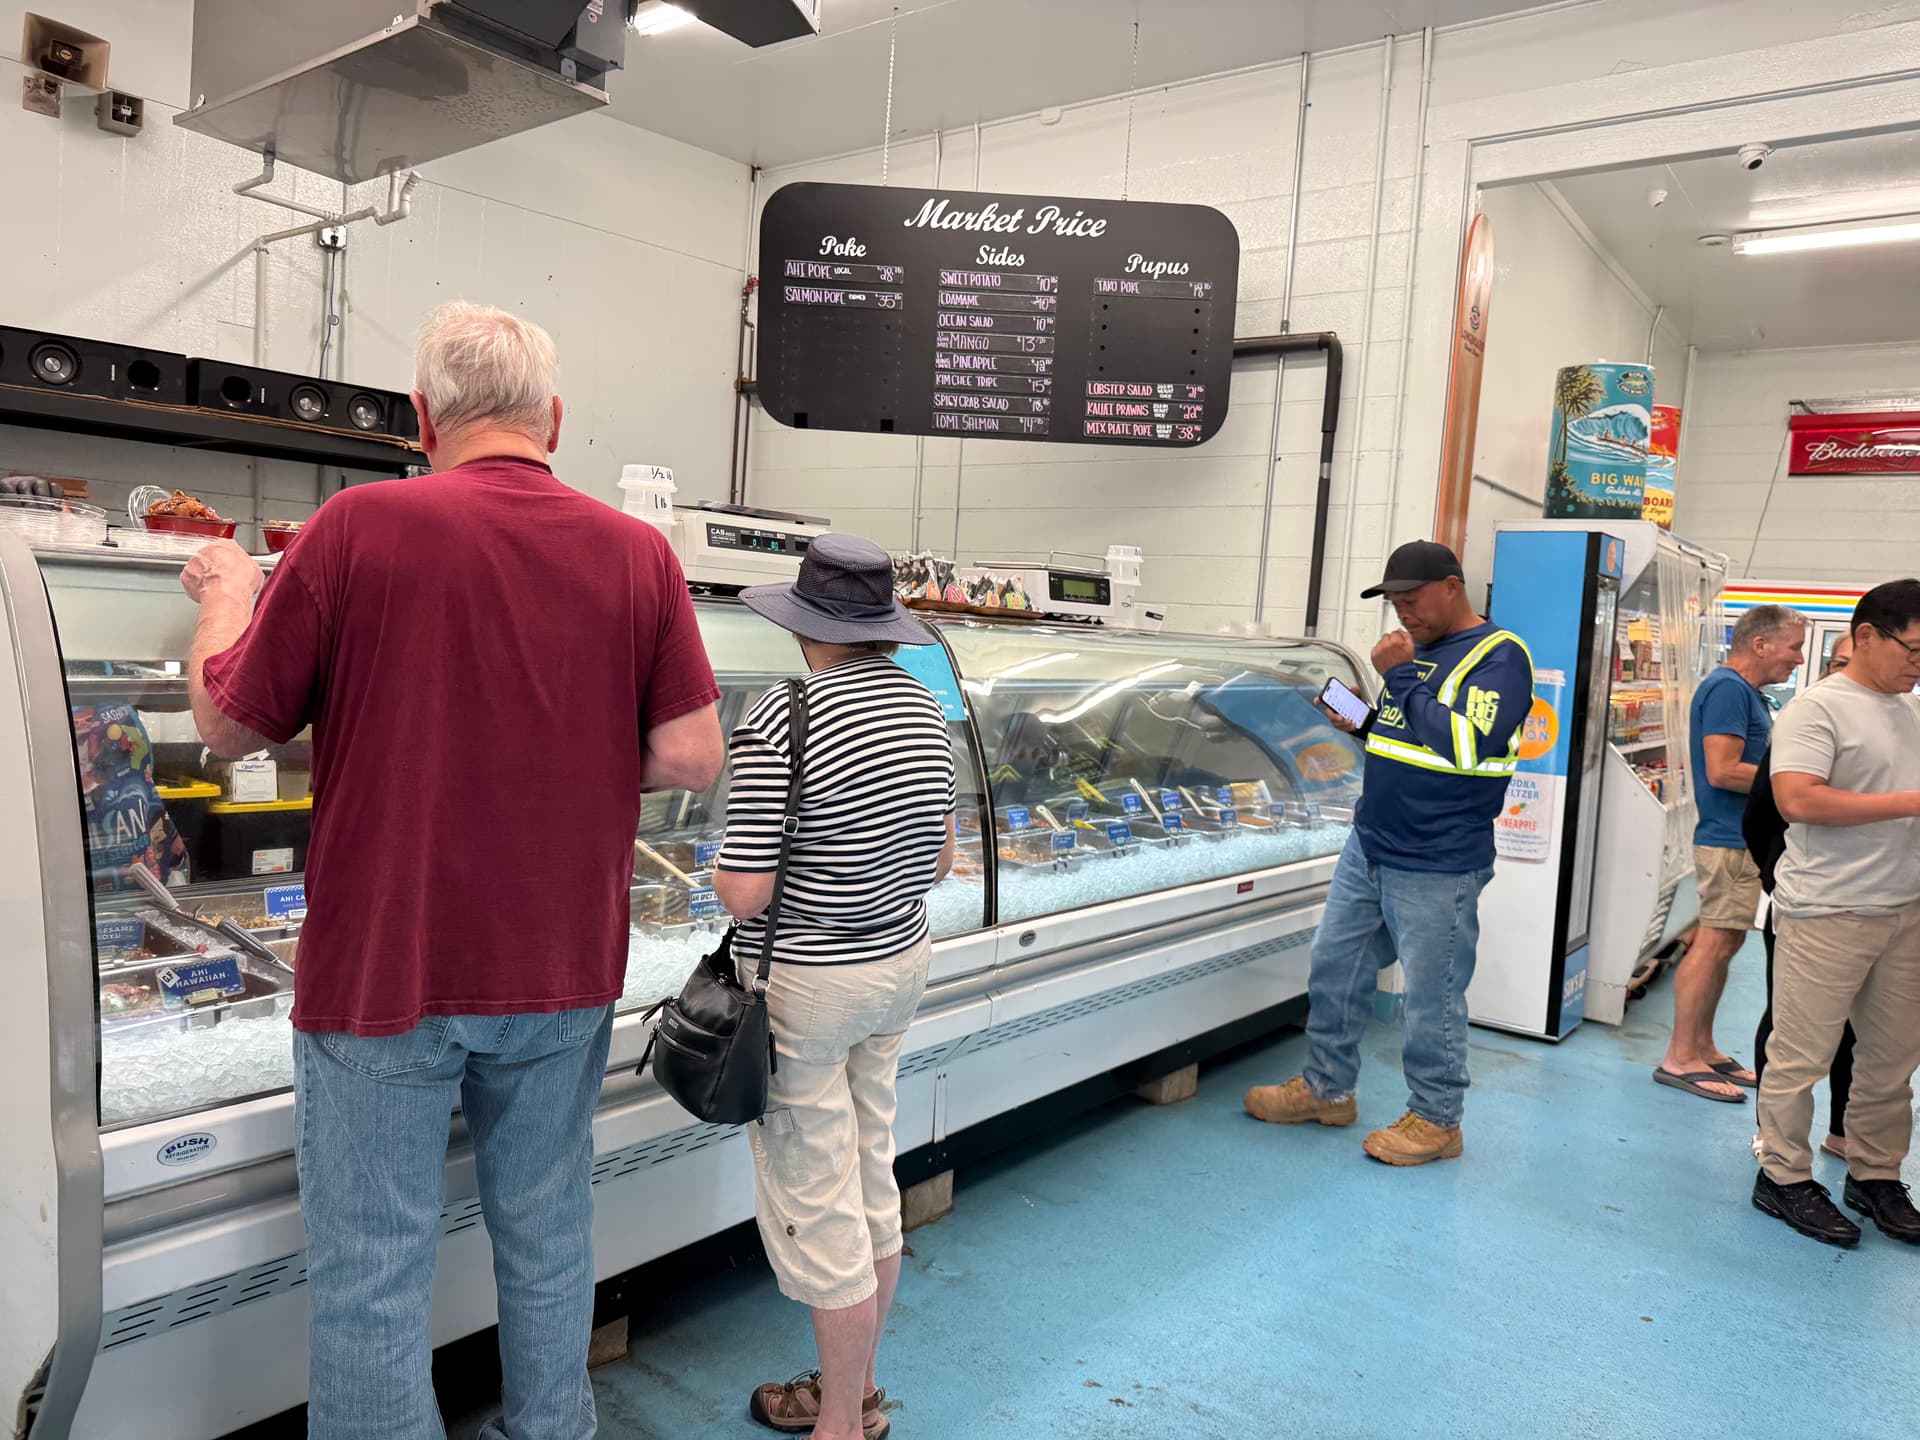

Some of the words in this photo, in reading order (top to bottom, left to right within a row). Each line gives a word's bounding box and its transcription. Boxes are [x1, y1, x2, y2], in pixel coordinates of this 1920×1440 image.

[904, 198, 1025, 233] Market
[1027, 205, 1107, 238] Price
[818, 235, 867, 257] Poke
[976, 245, 1025, 266] Sides
[786, 262, 805, 277] AHI
[808, 264, 833, 279] POKE
[1124, 253, 1189, 280] Pupus
[940, 271, 968, 286] SWEET
[970, 273, 1001, 287] POTATO
[1096, 280, 1117, 292] TAKO
[1121, 282, 1141, 294] POKE
[785, 288, 823, 303] SALMON
[824, 290, 846, 305] POKE
[940, 292, 980, 306] EDAMAME
[938, 313, 966, 327] OCEAN
[969, 315, 994, 328] SALAD
[950, 334, 990, 350] MANGO
[953, 354, 998, 370] PINEAPPLE
[976, 375, 999, 388] TRIPE
[1088, 383, 1125, 395] LOBSTER
[1127, 384, 1153, 396] SALAD
[934, 394, 958, 408] SPICY
[959, 396, 980, 409] CRAB
[982, 398, 1009, 411] SALAD
[1116, 404, 1149, 416] PRAWNS
[936, 414, 959, 429] LOMI
[962, 415, 999, 431] SALMON
[1086, 423, 1106, 434] MIX
[1108, 424, 1131, 435] PLATE
[1133, 425, 1153, 437] POKE
[651, 467, 665, 479] 1/2
[1591, 472, 1618, 486] BIG
[1525, 715, 1547, 728] GH
[1526, 729, 1548, 742] ON
[1510, 779, 1536, 789] ODKA
[1505, 788, 1539, 800] ELTZER
[280, 895, 293, 903] AHI
[175, 972, 226, 988] HAWAIIAN
[191, 968, 209, 977] AHI
[164, 1137, 209, 1154] BUSH
[164, 1144, 210, 1160] REFRIGERATION
